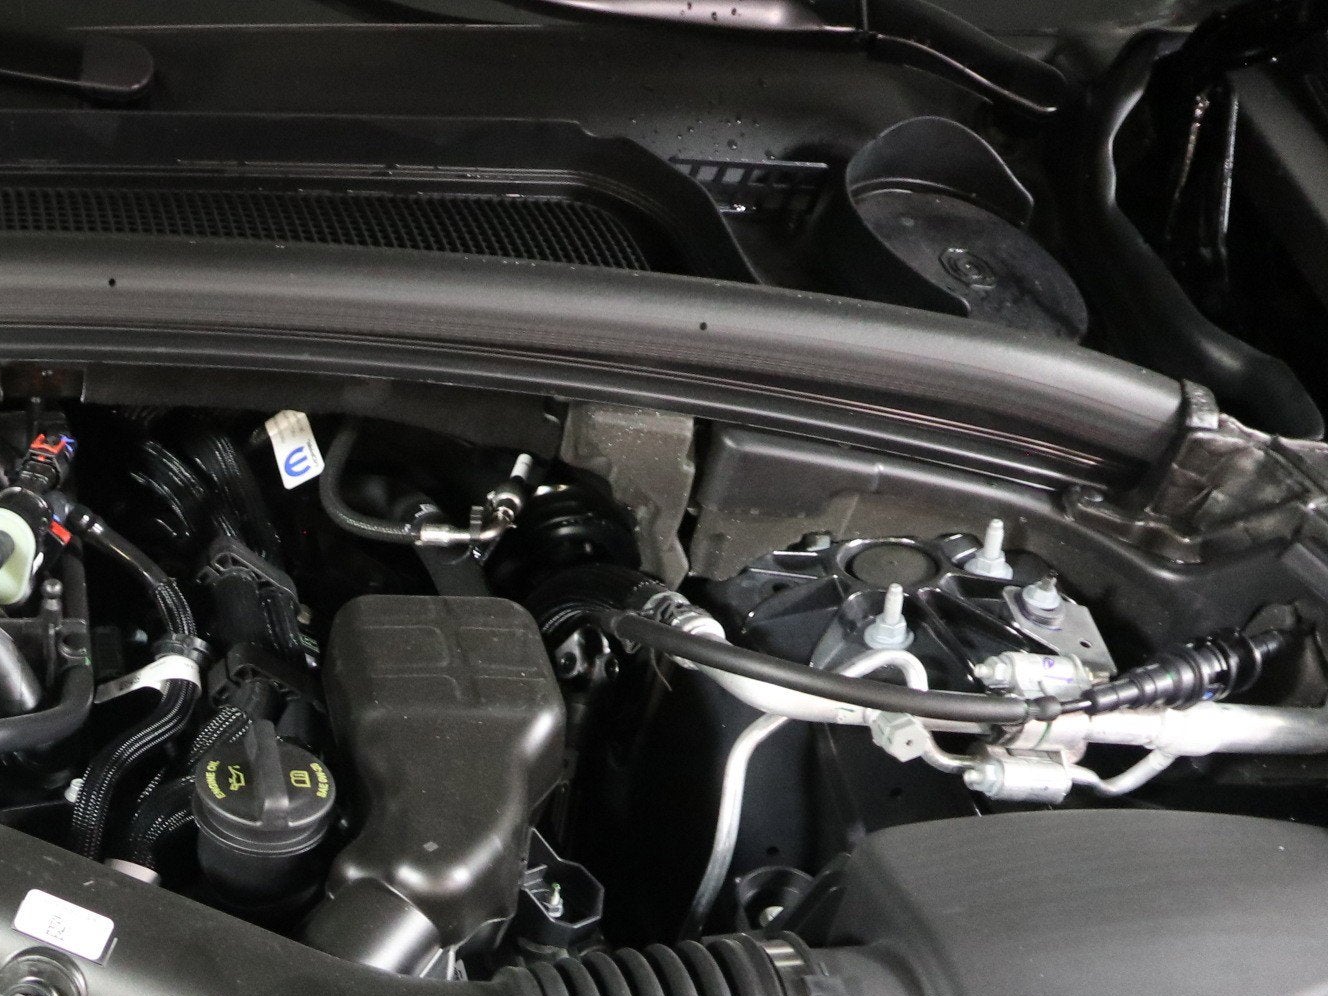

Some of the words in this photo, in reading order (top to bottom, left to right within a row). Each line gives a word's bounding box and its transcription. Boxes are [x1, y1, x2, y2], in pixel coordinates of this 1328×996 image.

[206, 760, 220, 772] OIL
[206, 771, 226, 799] ENGINE
[316, 783, 329, 798] SAE
